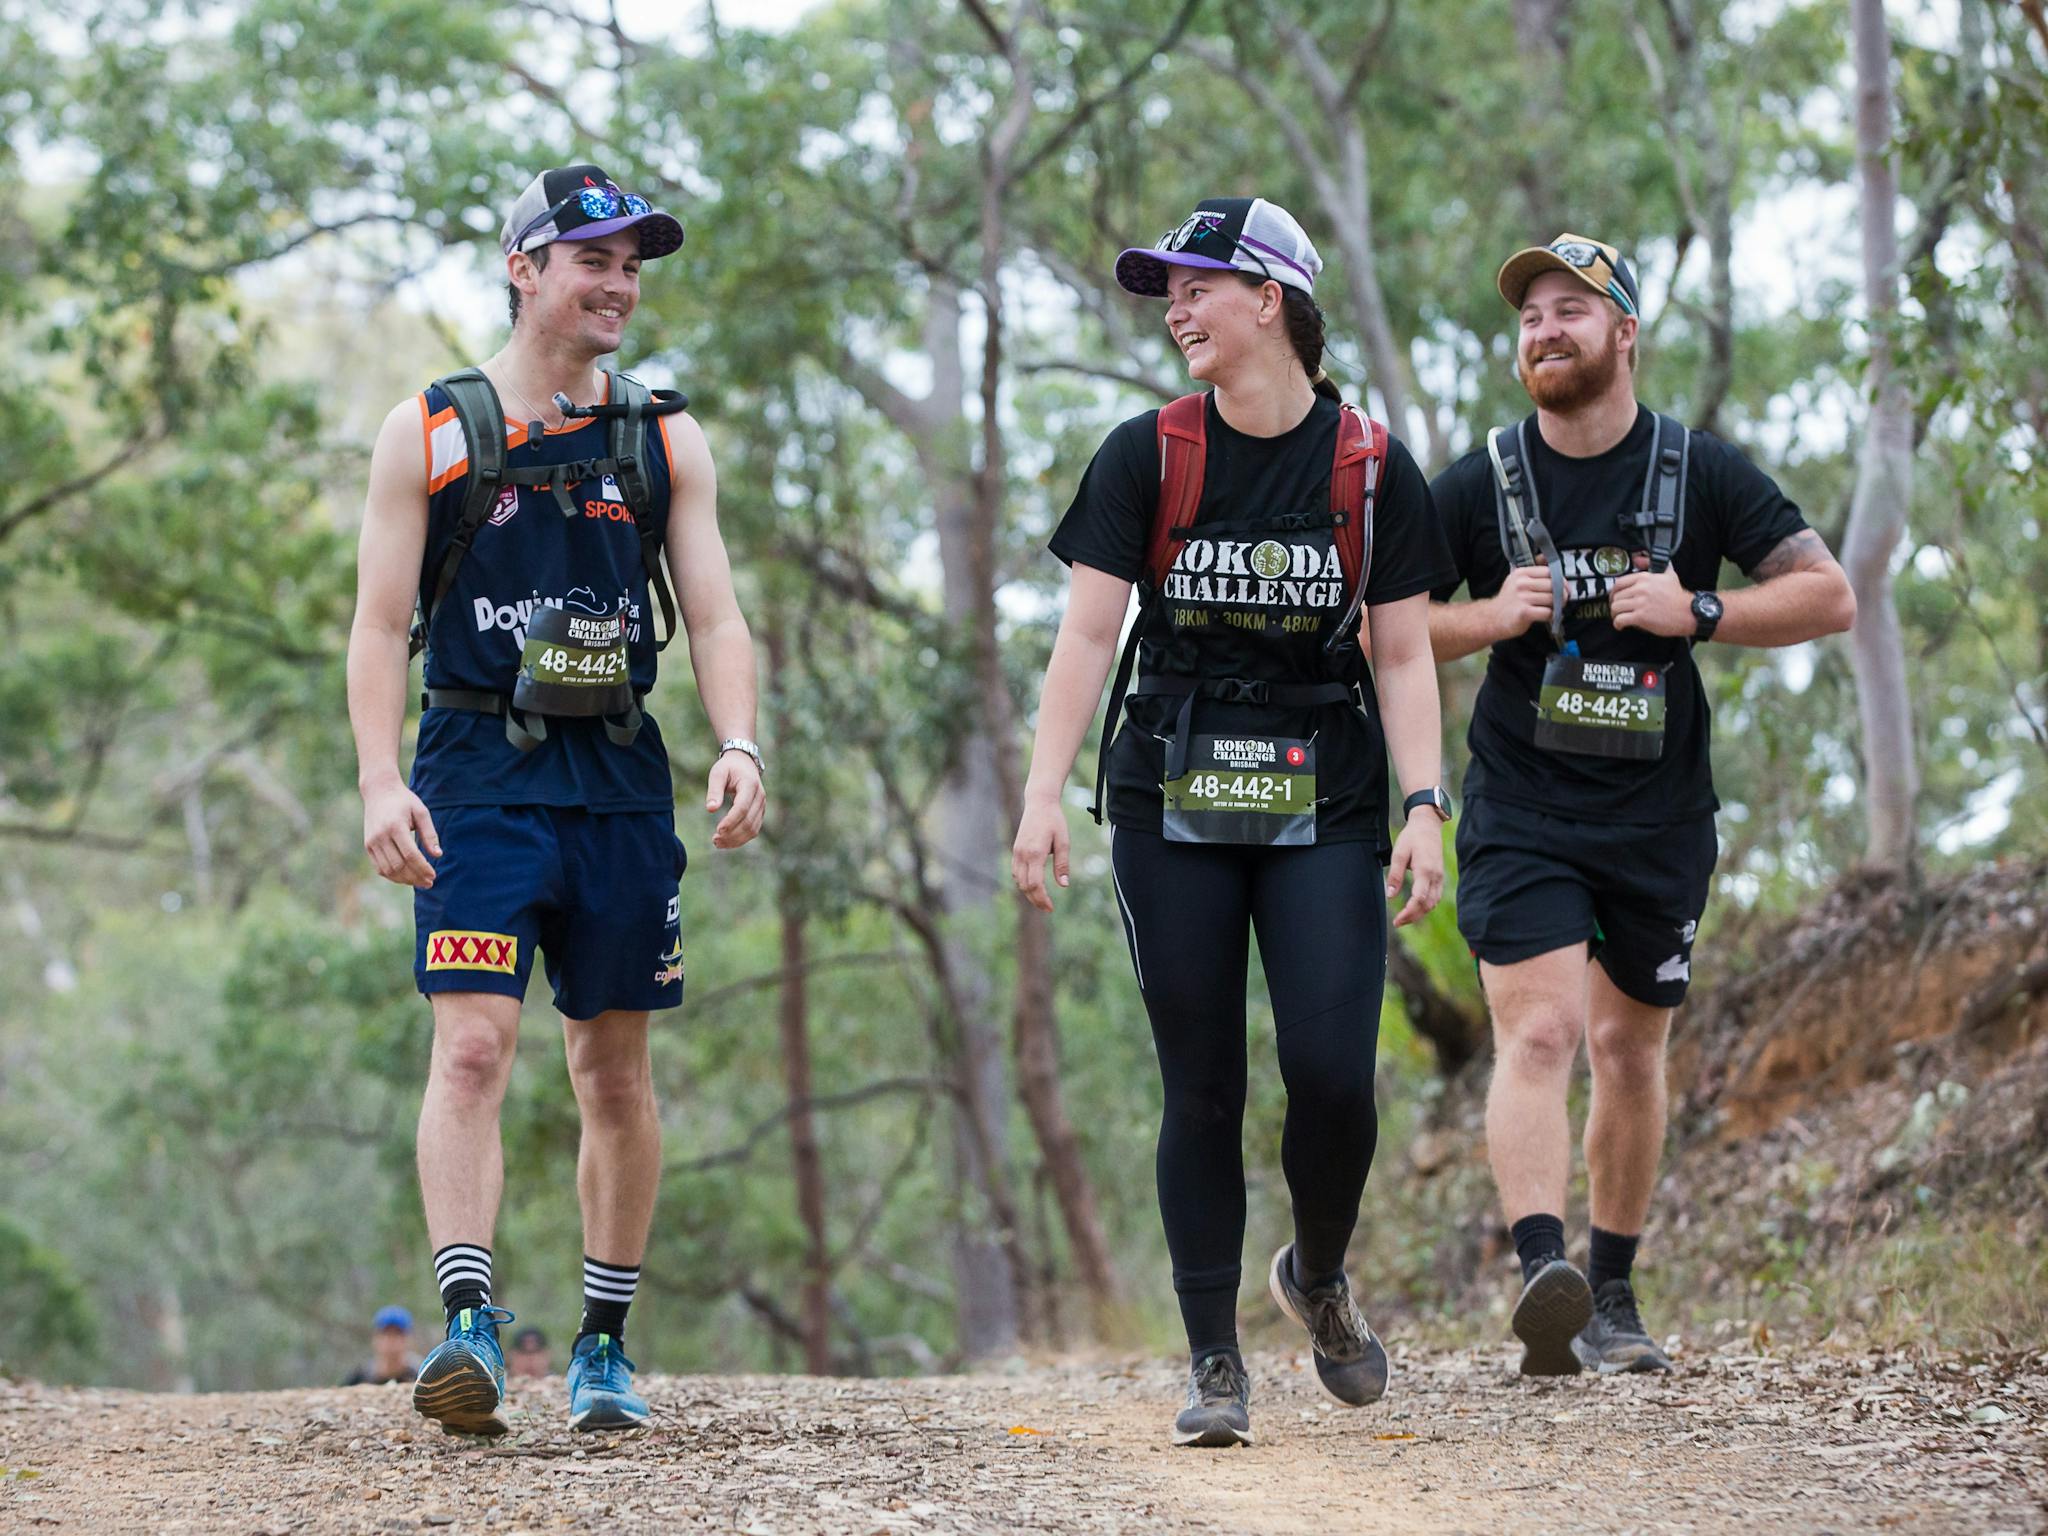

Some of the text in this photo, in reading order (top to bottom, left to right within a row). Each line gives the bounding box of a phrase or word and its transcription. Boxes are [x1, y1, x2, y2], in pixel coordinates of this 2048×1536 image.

[1164, 573, 1343, 607] CHALLENGE
[1174, 608, 1209, 626] 18KM
[1223, 611, 1266, 630] 30KM
[539, 647, 627, 675] 48-442-2
[1557, 692, 1649, 720] 48-442-3
[1213, 740, 1276, 753] KOKODA
[1213, 751, 1276, 762] CHALLENGE
[1292, 751, 1299, 761] 3
[1229, 761, 1260, 769] BRISBANE
[1189, 775, 1292, 801] 48-442-1
[430, 936, 512, 967] XXXX
